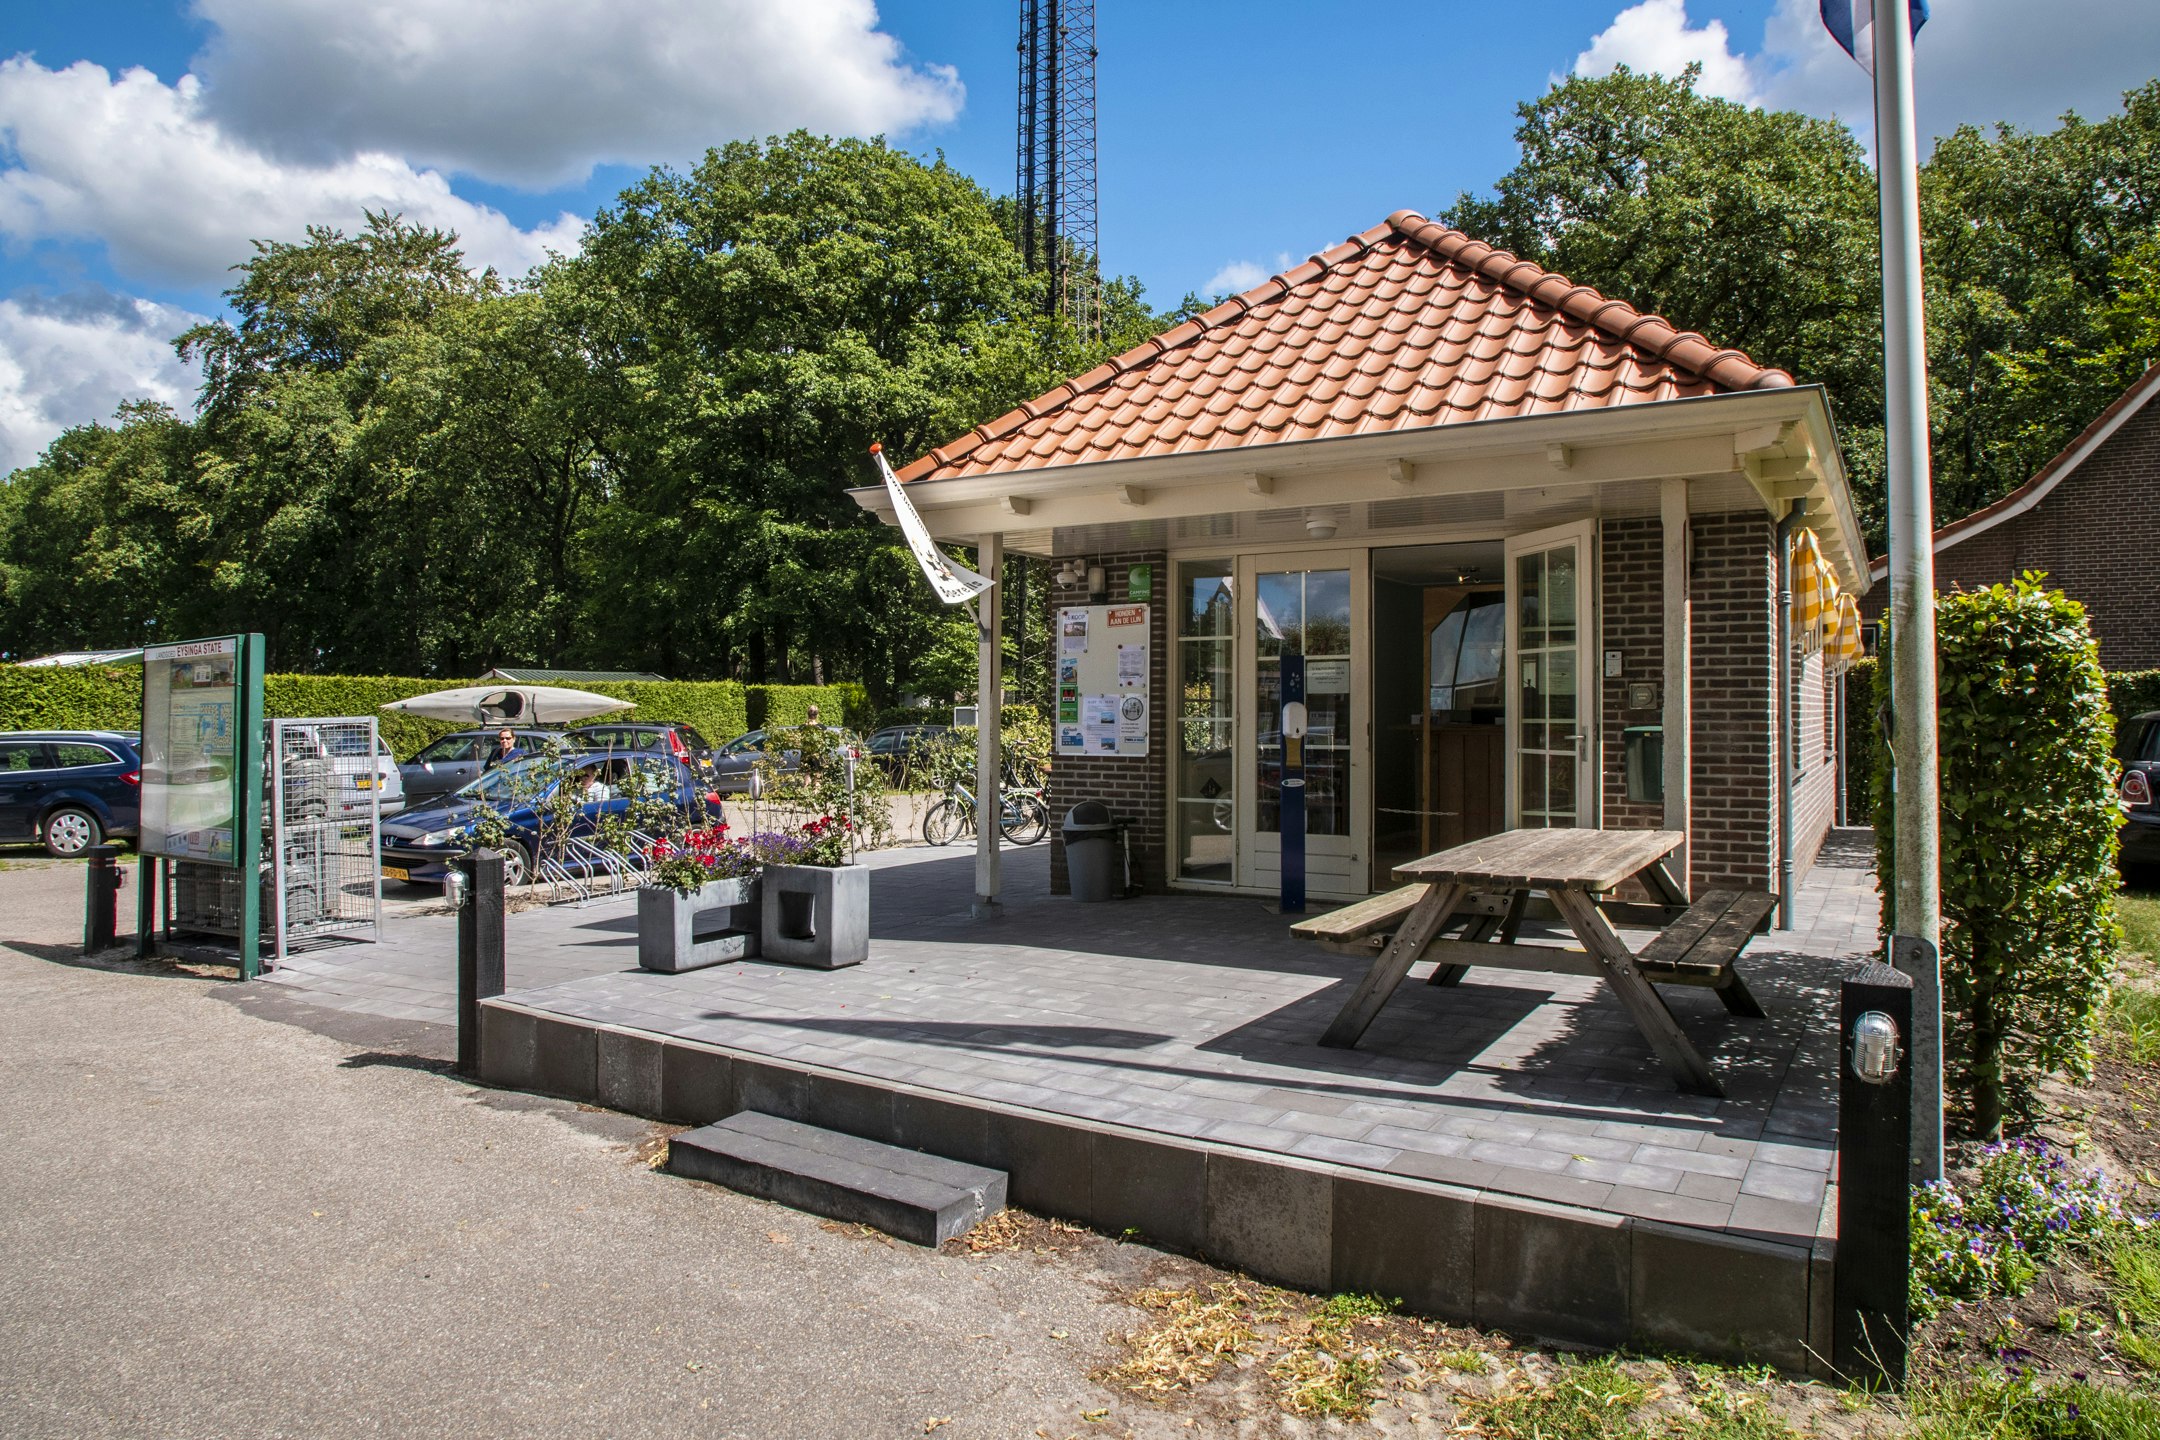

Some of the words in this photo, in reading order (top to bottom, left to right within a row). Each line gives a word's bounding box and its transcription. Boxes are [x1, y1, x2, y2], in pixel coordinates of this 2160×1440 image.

[1115, 609, 1136, 617] HONDEN
[177, 643, 202, 657] EYSINGA
[203, 642, 222, 655] STATE
